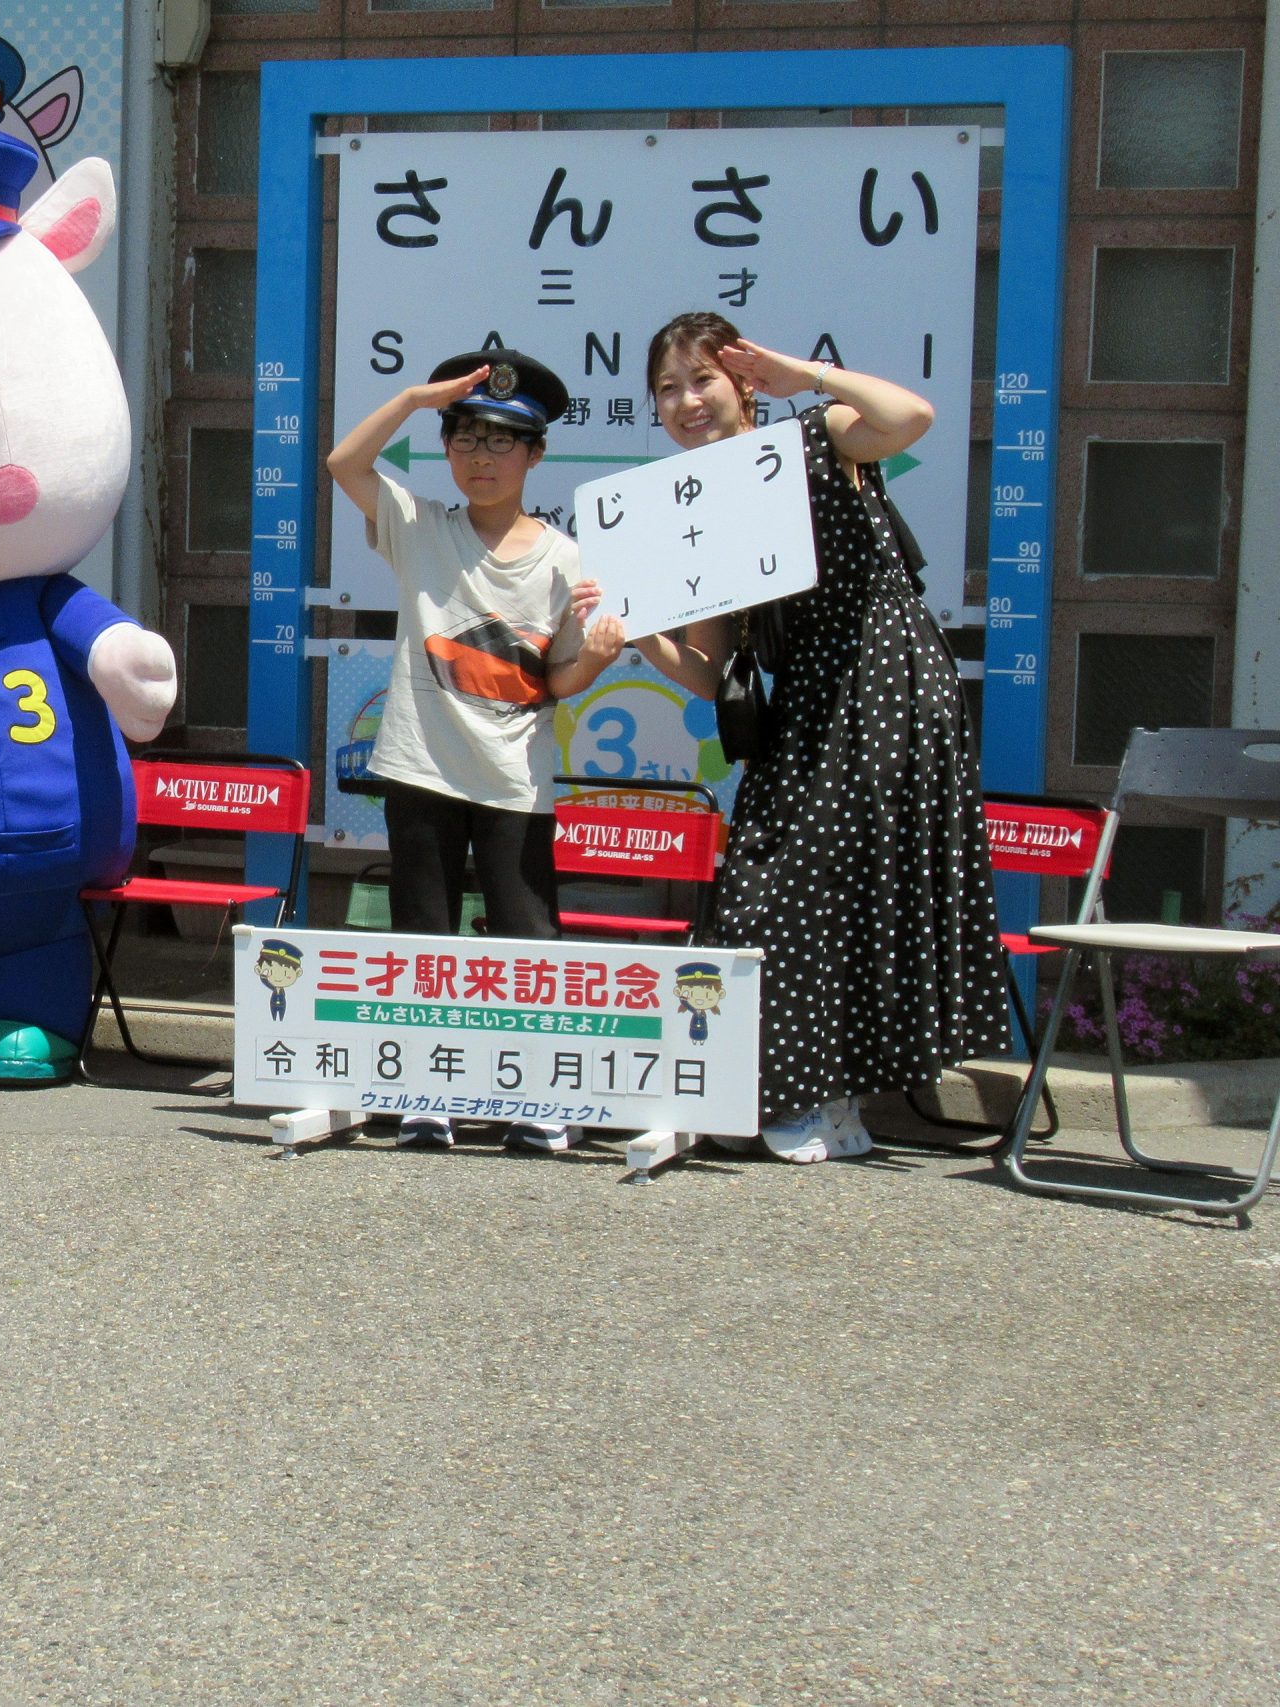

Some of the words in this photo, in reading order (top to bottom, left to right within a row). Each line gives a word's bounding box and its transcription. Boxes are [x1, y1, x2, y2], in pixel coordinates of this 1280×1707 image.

[373, 167, 940, 250] さんさい
[537, 267, 759, 307] 三才
[257, 362, 284, 377] 120
[258, 382, 278, 391] cm
[998, 373, 1028, 388] 120
[999, 395, 1021, 405] cm
[275, 415, 299, 430] 110
[279, 435, 299, 444] cm
[1017, 430, 1045, 445] 110
[1022, 451, 1044, 461] cm
[256, 467, 282, 482] 100
[256, 487, 276, 496] cm
[994, 486, 1024, 501] 100
[995, 507, 1017, 517] cm
[277, 520, 297, 534] 90
[277, 540, 296, 549] cm
[1019, 541, 1041, 557] 90
[1018, 564, 1040, 573] cm
[253, 572, 272, 586] 80
[254, 592, 273, 601] cm
[989, 597, 1011, 613] 80
[990, 619, 1012, 628] cm
[275, 625, 295, 640] 70
[274, 645, 294, 654] cm
[1014, 654, 1036, 670] 70
[1013, 675, 1035, 685] cm
[2, 669, 56, 743] 3
[165, 778, 220, 801] ACTIVE
[224, 782, 268, 805] FIELD
[197, 803, 228, 813] SOURIRE
[564, 823, 621, 848] ACTIVE
[625, 828, 671, 851] FIELD
[1022, 823, 1071, 847] FIELD
[597, 849, 630, 859] SOURIRE
[995, 845, 1028, 854] SOURIRE
[317, 950, 661, 1010] 三才駅来訪記念
[360, 1091, 613, 1123] ウェルカム三才児プロジェクト
